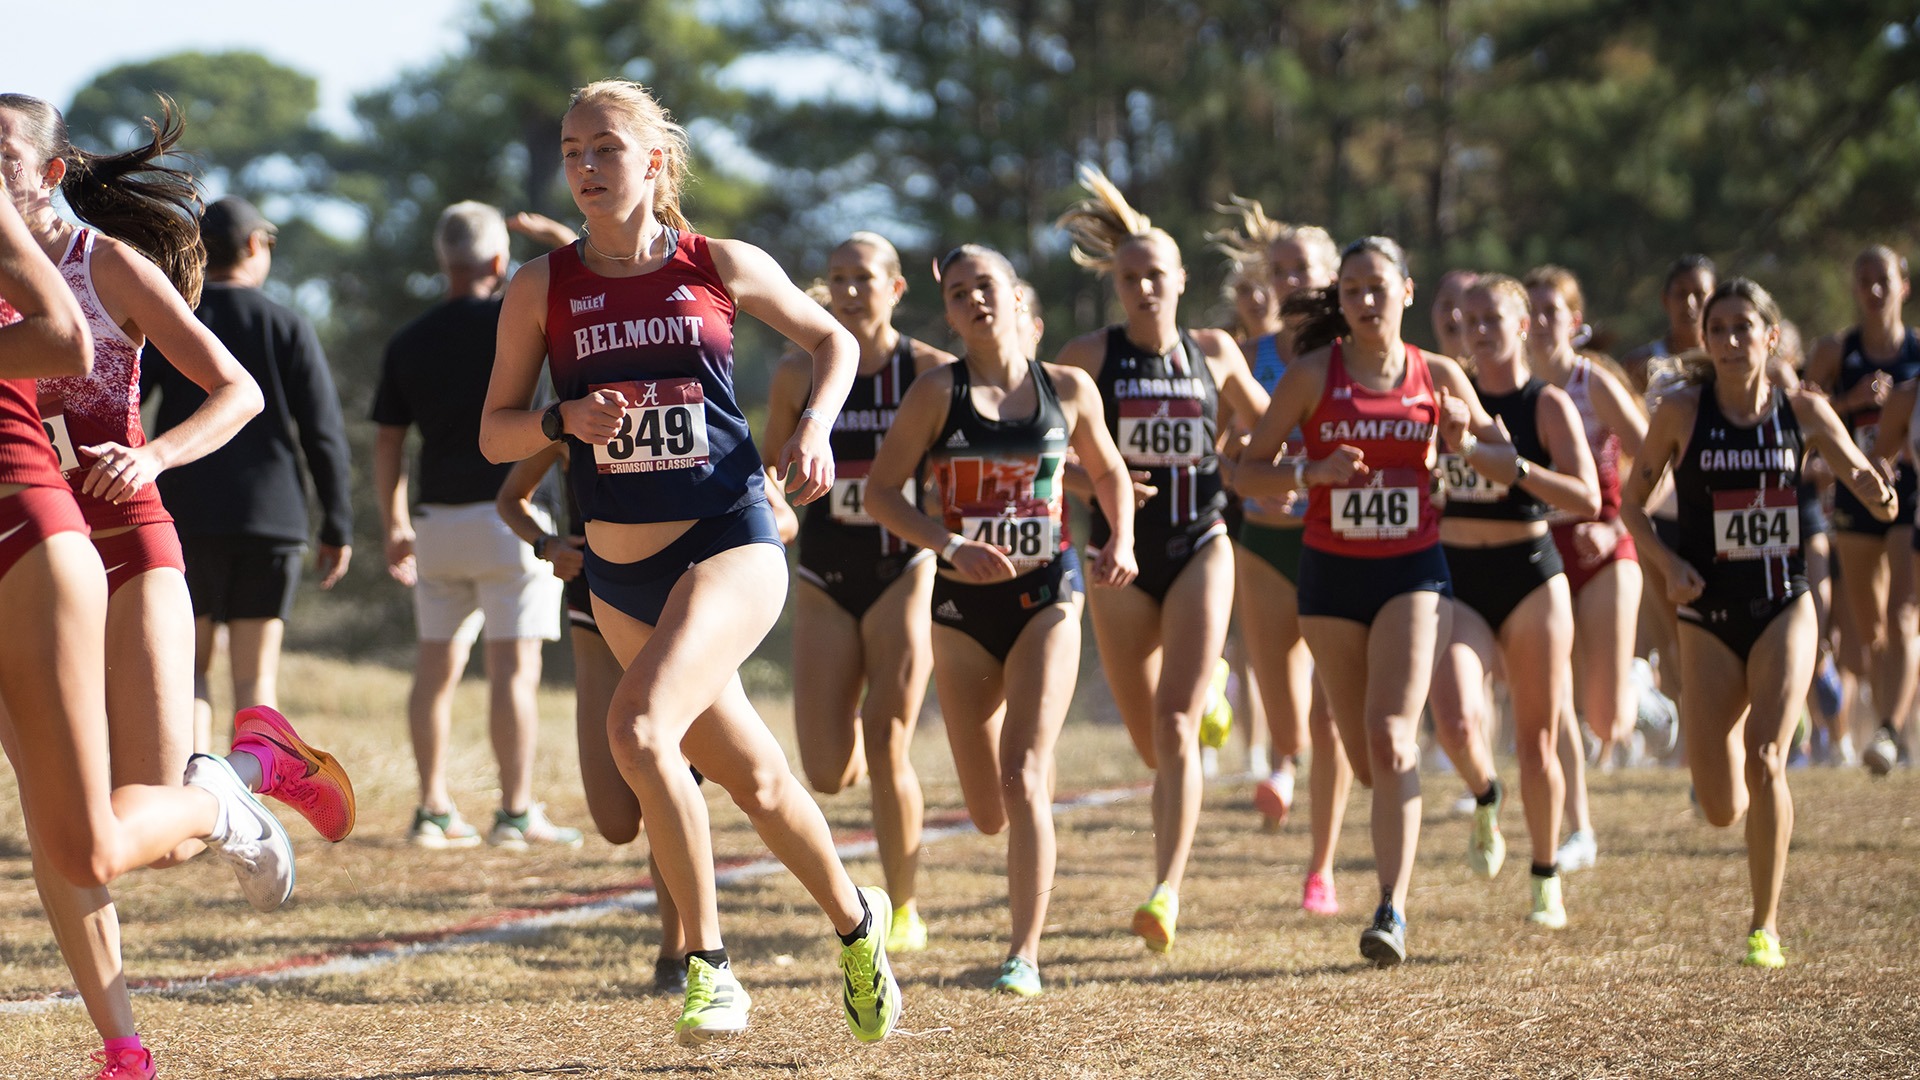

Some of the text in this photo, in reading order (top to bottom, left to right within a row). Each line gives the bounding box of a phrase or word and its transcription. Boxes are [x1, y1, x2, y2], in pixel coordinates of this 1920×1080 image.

[570, 293, 606, 313] VALLEY
[574, 316, 704, 361] BELMONT
[635, 382, 659, 407] A
[1114, 378, 1207, 400] CAROLINA
[607, 407, 694, 460] 349
[1129, 420, 1192, 453] 466
[610, 458, 695, 474] CRIMSON CLASSIC
[1700, 448, 1796, 472] CAROLINA
[1343, 490, 1409, 526] 446
[1726, 510, 1790, 547] 464
